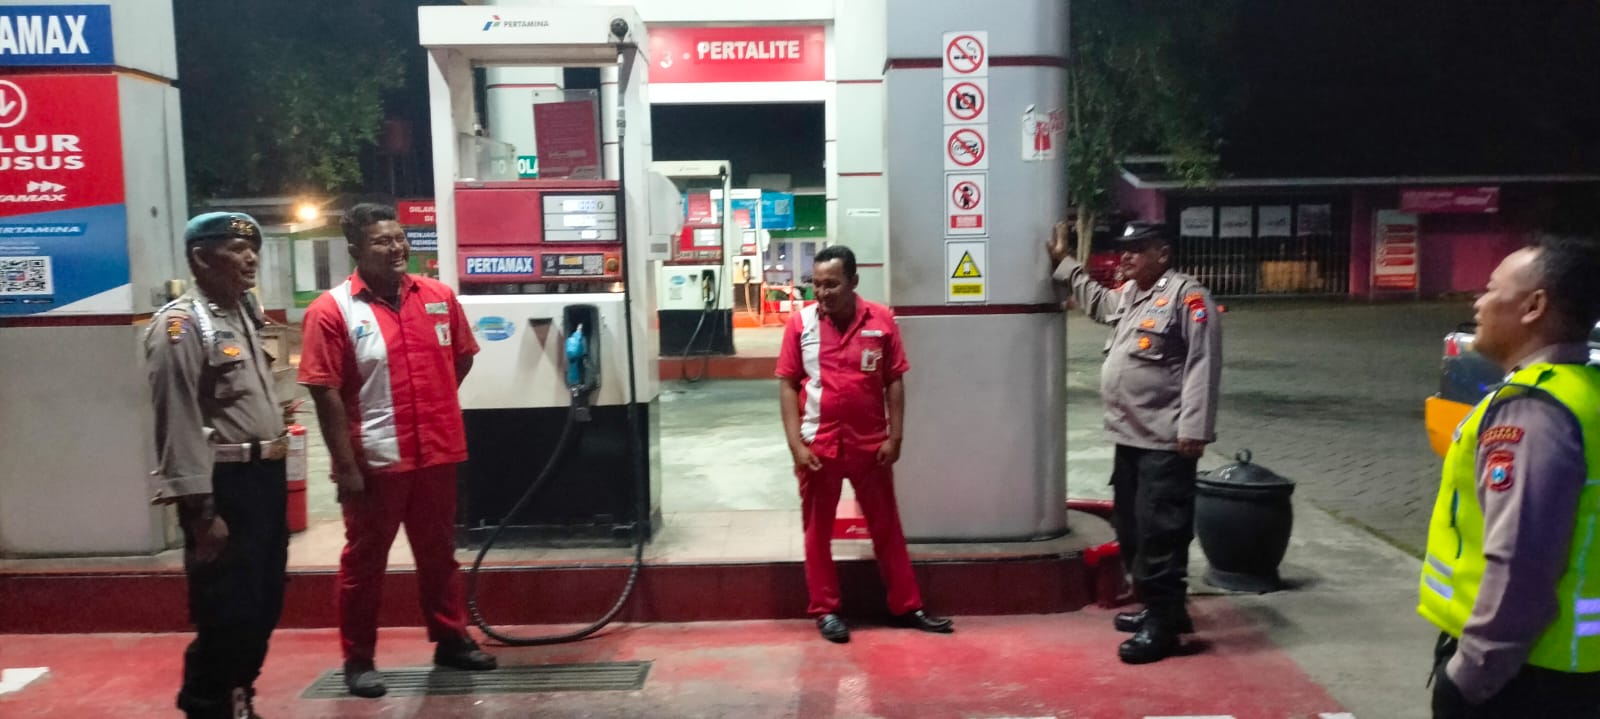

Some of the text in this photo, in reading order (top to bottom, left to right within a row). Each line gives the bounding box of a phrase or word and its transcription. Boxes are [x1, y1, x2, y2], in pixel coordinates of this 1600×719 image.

[503, 20, 549, 28] PERTAMINA
[0, 14, 90, 55] AMAX
[697, 39, 800, 60] PERTALITE
[467, 257, 533, 274] PERTAMAX
